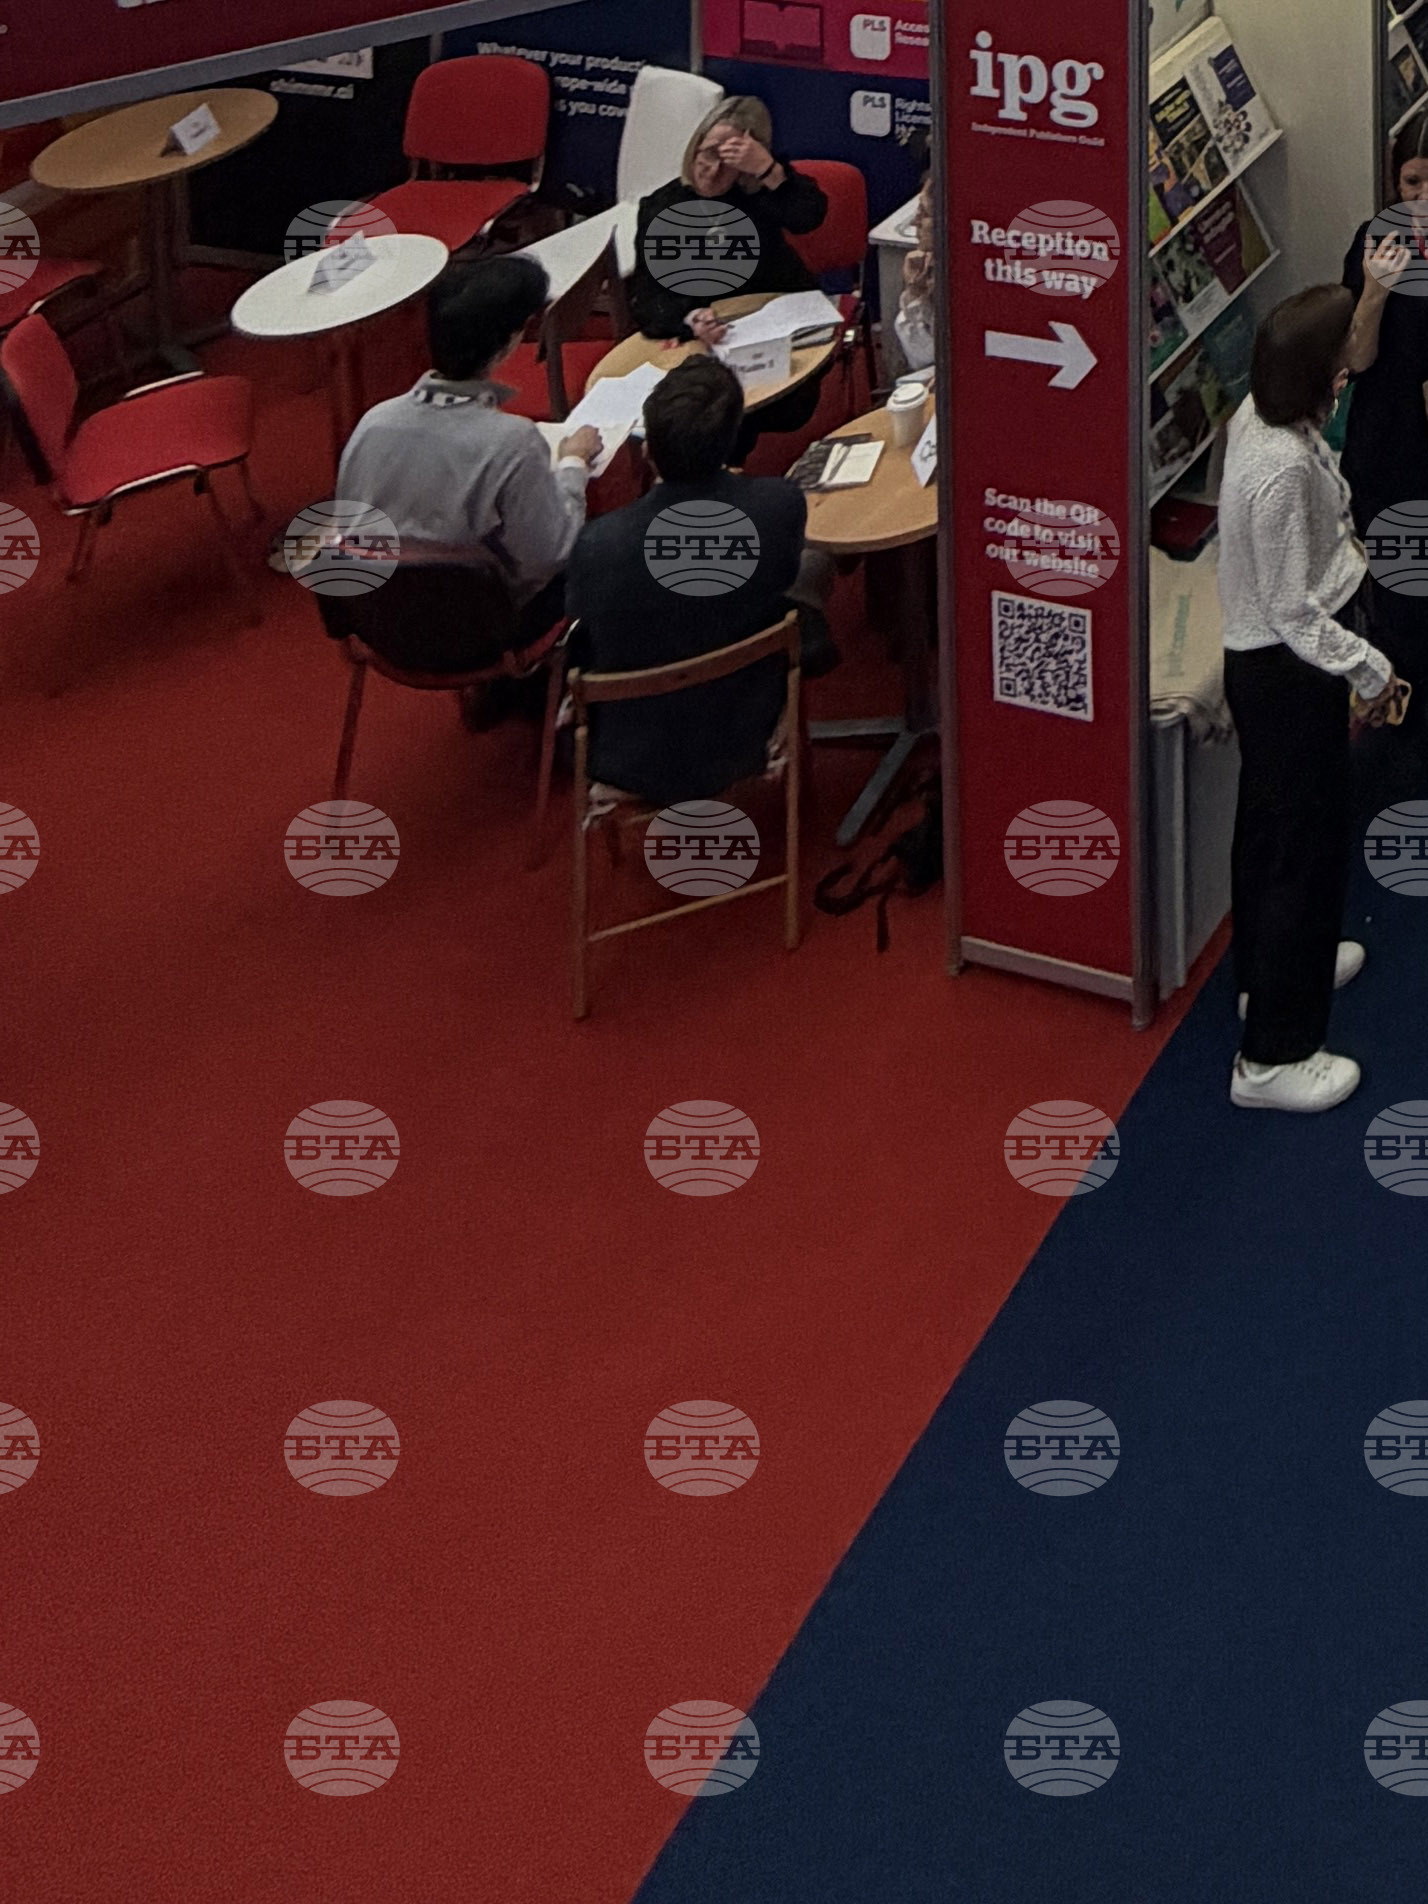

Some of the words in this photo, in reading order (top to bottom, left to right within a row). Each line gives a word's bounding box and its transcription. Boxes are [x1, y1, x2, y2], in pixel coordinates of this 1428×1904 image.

[970, 30, 1104, 128] ipg
[970, 219, 1110, 262] Reception
[984, 257, 1037, 288] this
[1042, 269, 1097, 299] way
[984, 487, 1034, 515] Scan
[1035, 493, 1067, 518] the
[1070, 503, 1102, 527] QR
[983, 515, 1030, 539] code
[1032, 522, 1053, 544] to
[1057, 528, 1103, 554] visit
[986, 541, 1026, 563] our
[1026, 547, 1099, 579] website
